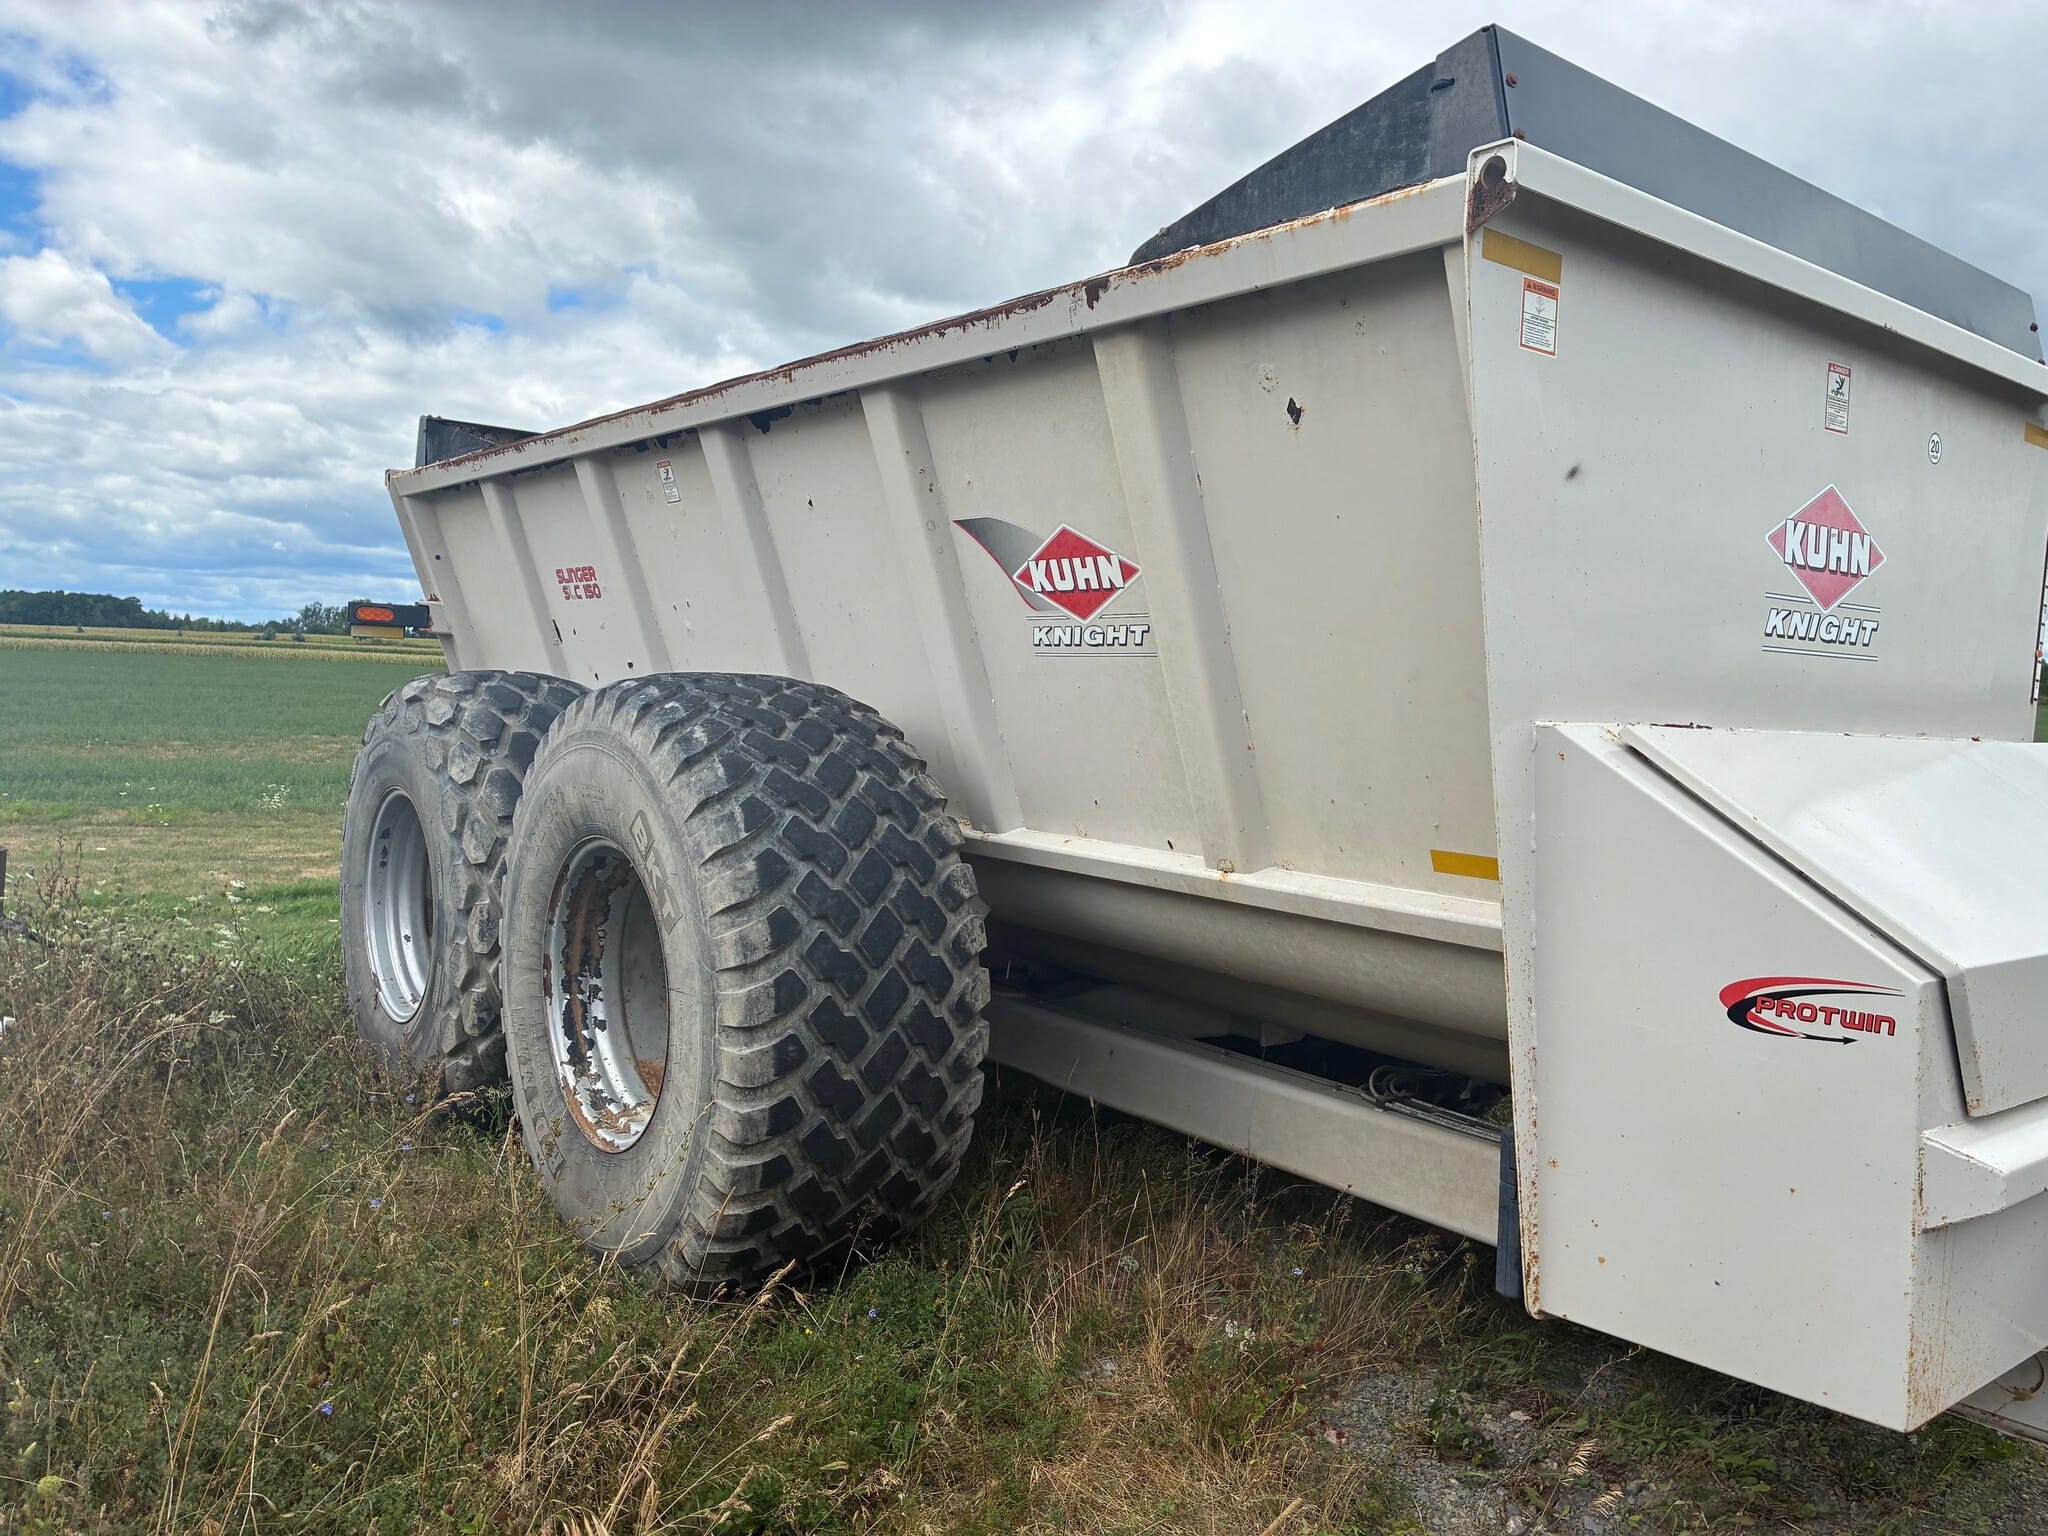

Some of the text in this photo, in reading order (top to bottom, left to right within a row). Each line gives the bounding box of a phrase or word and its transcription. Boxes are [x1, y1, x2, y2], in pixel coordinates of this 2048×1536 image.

[1532, 282, 1556, 297] WARNING
[1930, 439, 1940, 454] 20
[1784, 518, 1871, 578] KUHN
[555, 565, 598, 584] SLINGER
[1027, 554, 1125, 594] KUHN
[583, 583, 602, 599] 150
[1032, 624, 1149, 647] KNIGHT
[1764, 607, 1878, 647] KNIGHT
[631, 814, 682, 925] BKT
[1755, 996, 1897, 1037] PROTWIN
